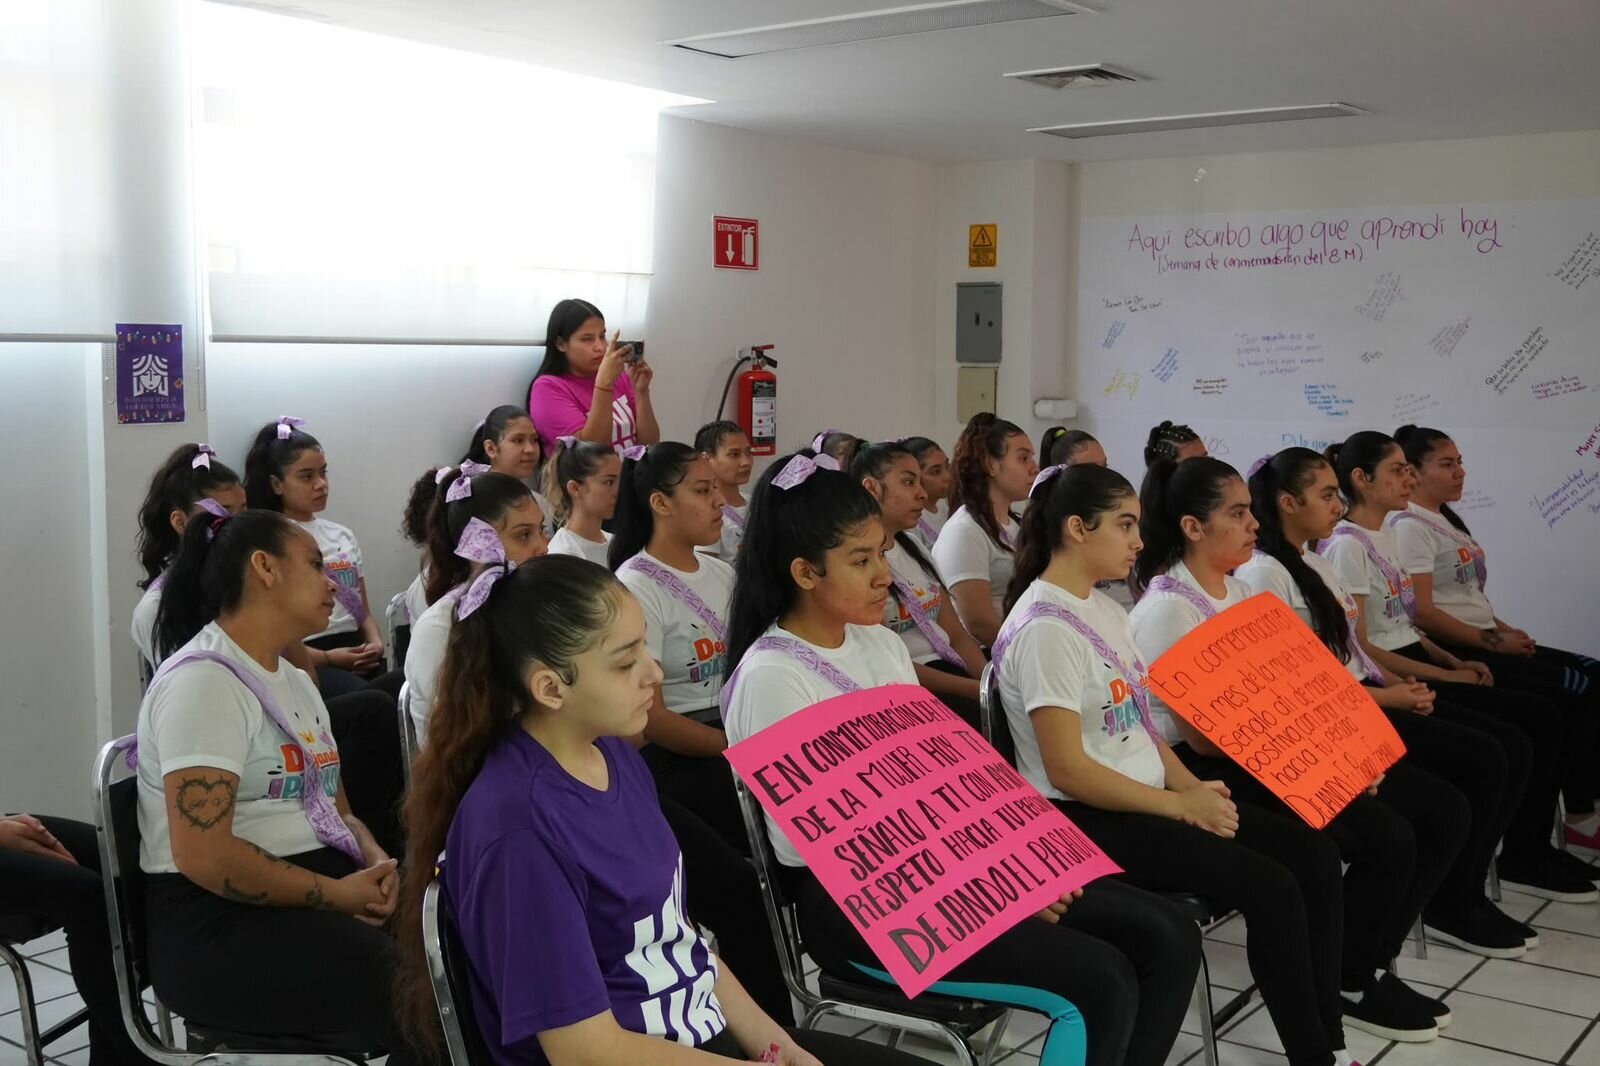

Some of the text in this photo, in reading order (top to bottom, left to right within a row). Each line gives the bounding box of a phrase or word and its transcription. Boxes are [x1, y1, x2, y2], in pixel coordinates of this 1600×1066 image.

[1184, 222, 1250, 249] escribo
[1260, 223, 1304, 253] algo
[1311, 219, 1350, 257] que
[1460, 207, 1504, 254] hoy
[1205, 251, 1219, 270] de
[1303, 248, 1323, 266] del
[1148, 667, 1197, 700] En
[1191, 702, 1217, 734] el
[1210, 683, 1249, 718] mes
[753, 752, 813, 807] EN
[790, 729, 991, 843] DE LA MUJER HOY TE
[959, 772, 997, 803] CON
[1270, 738, 1320, 788] hacia
[925, 801, 948, 831] A
[931, 780, 966, 815] TI
[833, 807, 928, 883] SEÑALO
[843, 848, 946, 930] RESPETO
[940, 818, 999, 862] HACIA
[992, 805, 1023, 833] TU
[887, 865, 1015, 975] DEJANDO
[1008, 852, 1046, 890] EL
